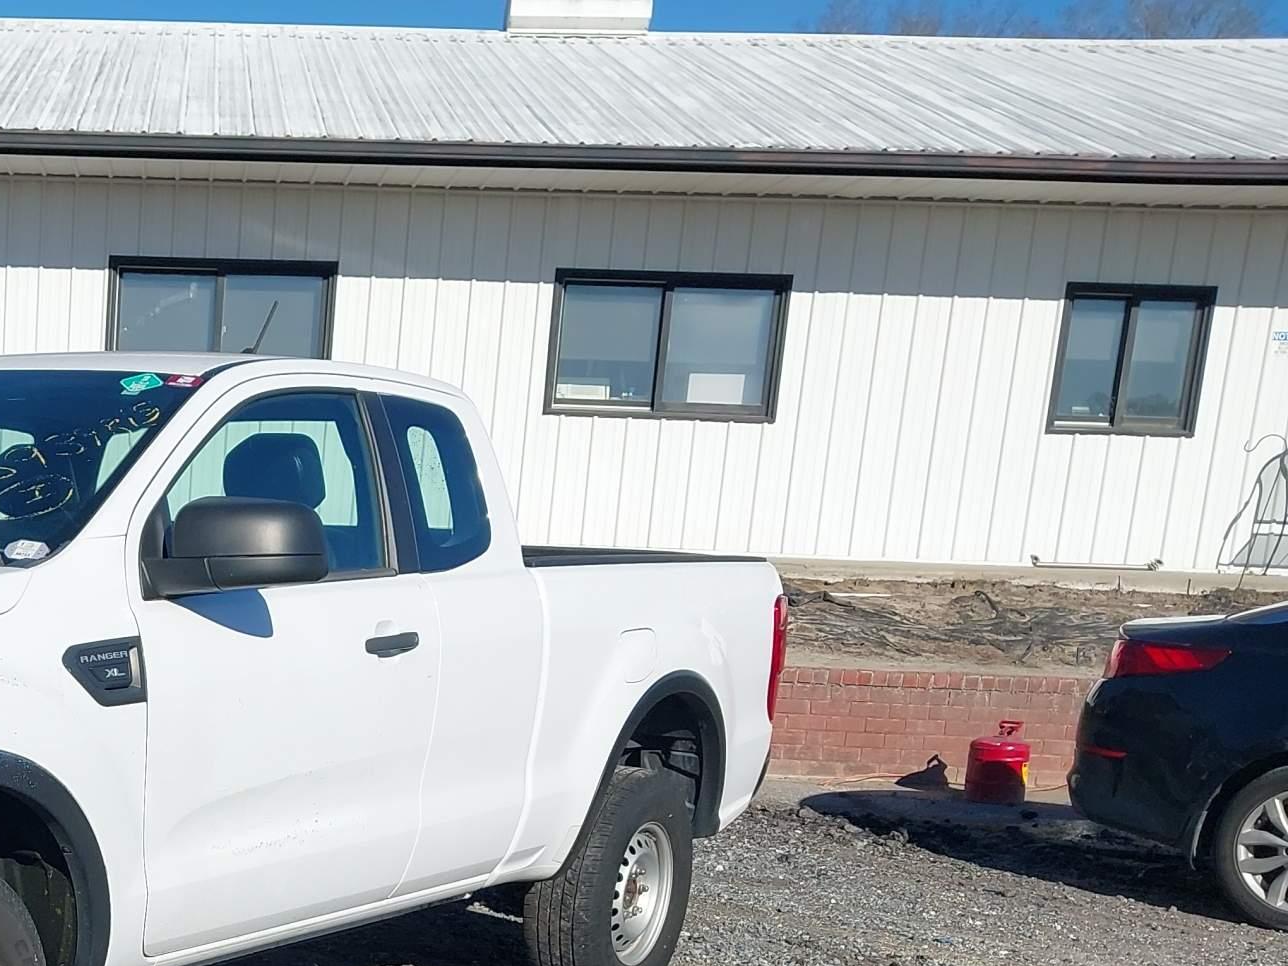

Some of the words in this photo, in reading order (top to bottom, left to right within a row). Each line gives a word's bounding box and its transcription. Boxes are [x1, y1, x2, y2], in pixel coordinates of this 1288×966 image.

[1272, 331, 1288, 340] NO
[80, 650, 129, 664] RANGER
[104, 667, 127, 678] XL
